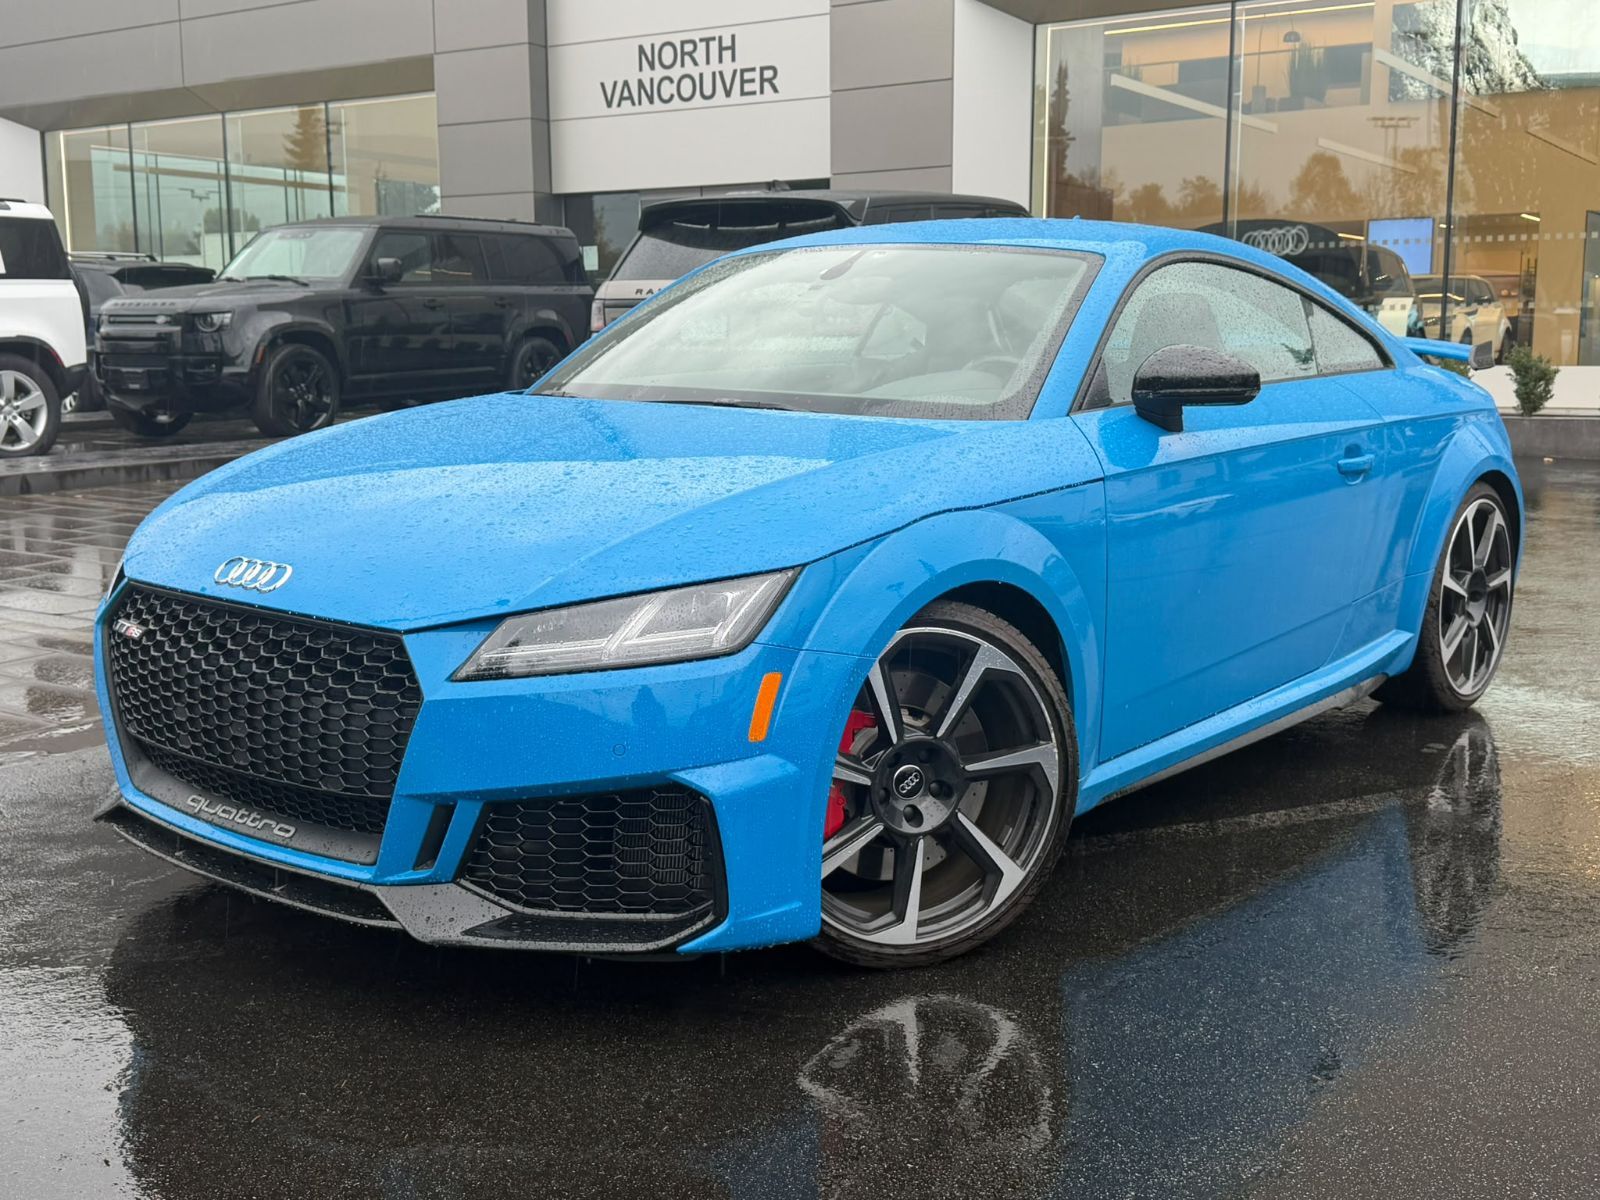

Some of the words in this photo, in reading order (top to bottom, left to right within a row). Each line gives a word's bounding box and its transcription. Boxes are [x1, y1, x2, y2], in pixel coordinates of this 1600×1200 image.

[637, 34, 736, 72] NORTH
[600, 65, 779, 108] VANCOUVER
[635, 288, 661, 296] RA
[186, 794, 296, 838] quattro
